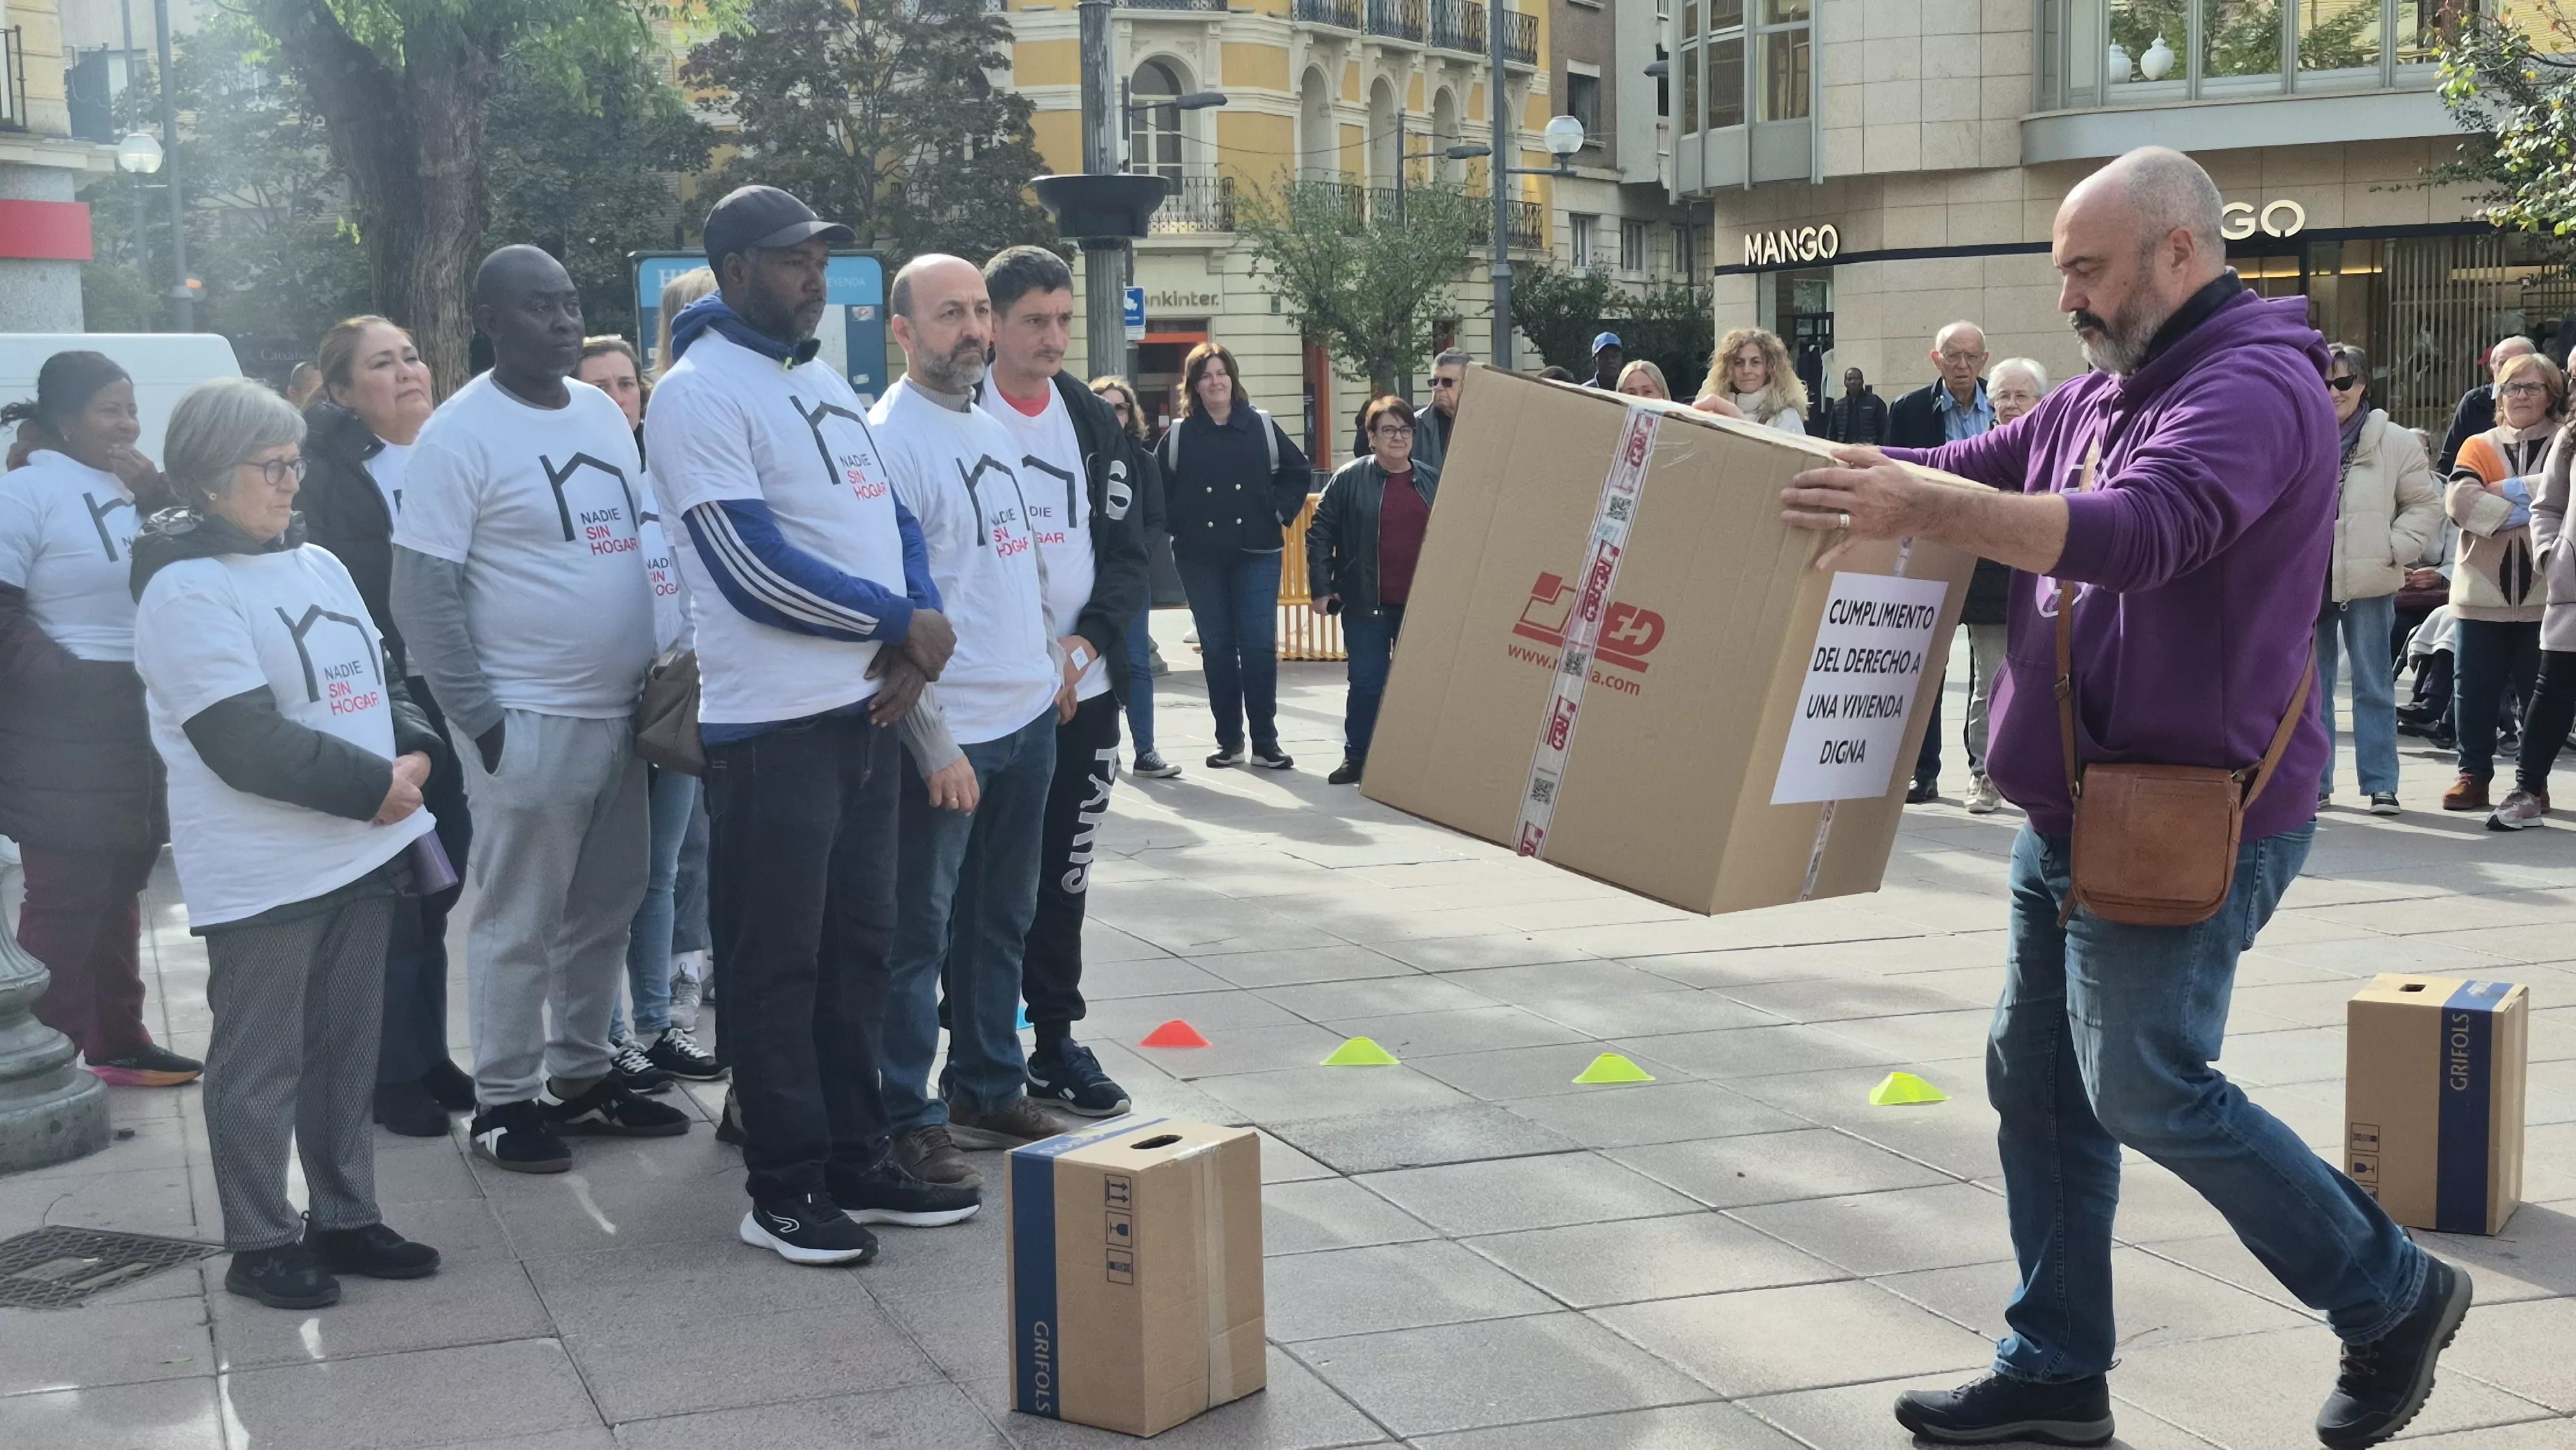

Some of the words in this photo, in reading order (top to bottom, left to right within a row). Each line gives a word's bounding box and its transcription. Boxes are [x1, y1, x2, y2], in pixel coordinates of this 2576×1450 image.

[1744, 224, 1839, 266] MANGO
[1145, 290, 1219, 307] nkinter.
[839, 454, 871, 467] NADIE
[848, 469, 866, 484] SIN
[580, 508, 621, 524] NADIE
[1029, 506, 1052, 517] DIE
[586, 525, 611, 540] SIN
[590, 538, 638, 556] HOGAR
[1830, 599, 1934, 629] CUMPLIMIENTO
[324, 660, 363, 681] NADIE
[1813, 647, 1841, 672] DEL
[1843, 648, 1911, 673] DERECHO
[1909, 652, 1921, 674] A
[329, 680, 352, 698] SIN
[330, 692, 379, 715] HOGAR
[1806, 694, 1838, 719] UNA
[1842, 694, 1904, 719] VIVIENDA
[1819, 740, 1866, 764] DIGNA
[2450, 1013, 2469, 1091] GRIFOLS
[1034, 1321, 1051, 1413] GRIFOLS
